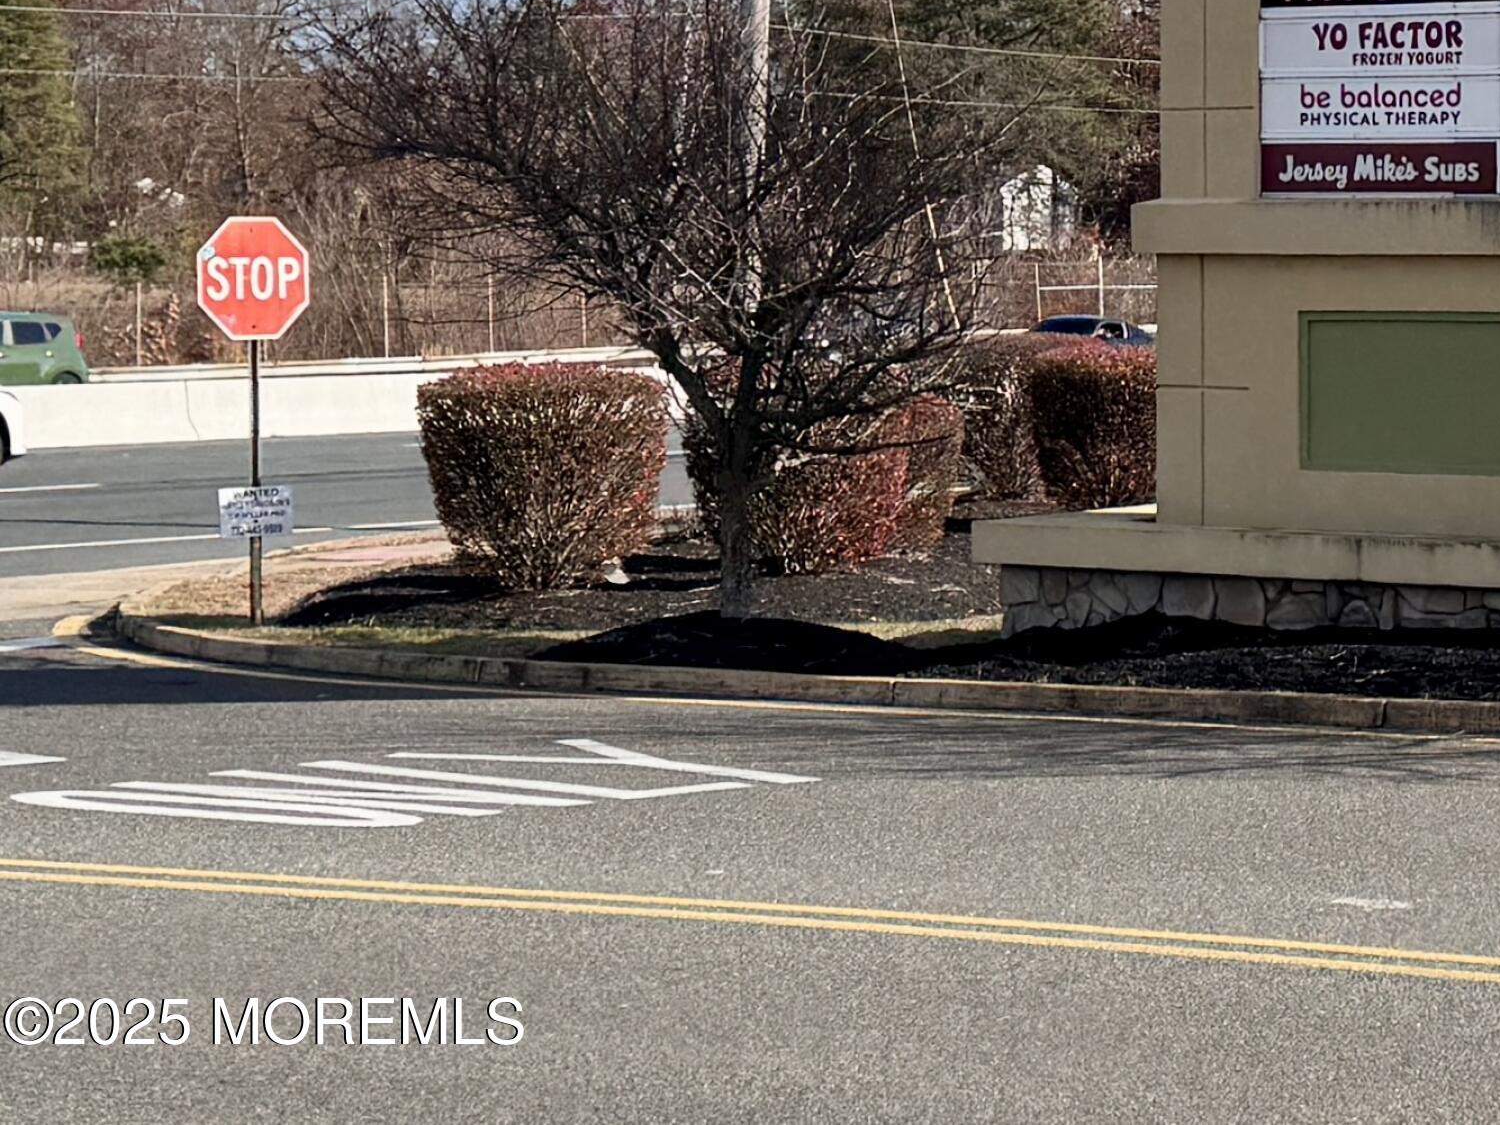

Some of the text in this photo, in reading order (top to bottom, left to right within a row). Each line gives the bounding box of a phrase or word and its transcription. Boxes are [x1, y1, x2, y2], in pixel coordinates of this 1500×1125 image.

[1312, 20, 1463, 51] YO FACTOR
[1352, 51, 1463, 66] FROZEN YOGURT
[1300, 82, 1462, 108] be balanced
[1300, 111, 1461, 126] PHYSICAL THERAPY
[1279, 155, 1348, 189] Jersey
[1354, 154, 1419, 182] Mike's
[206, 255, 300, 302] STOP
